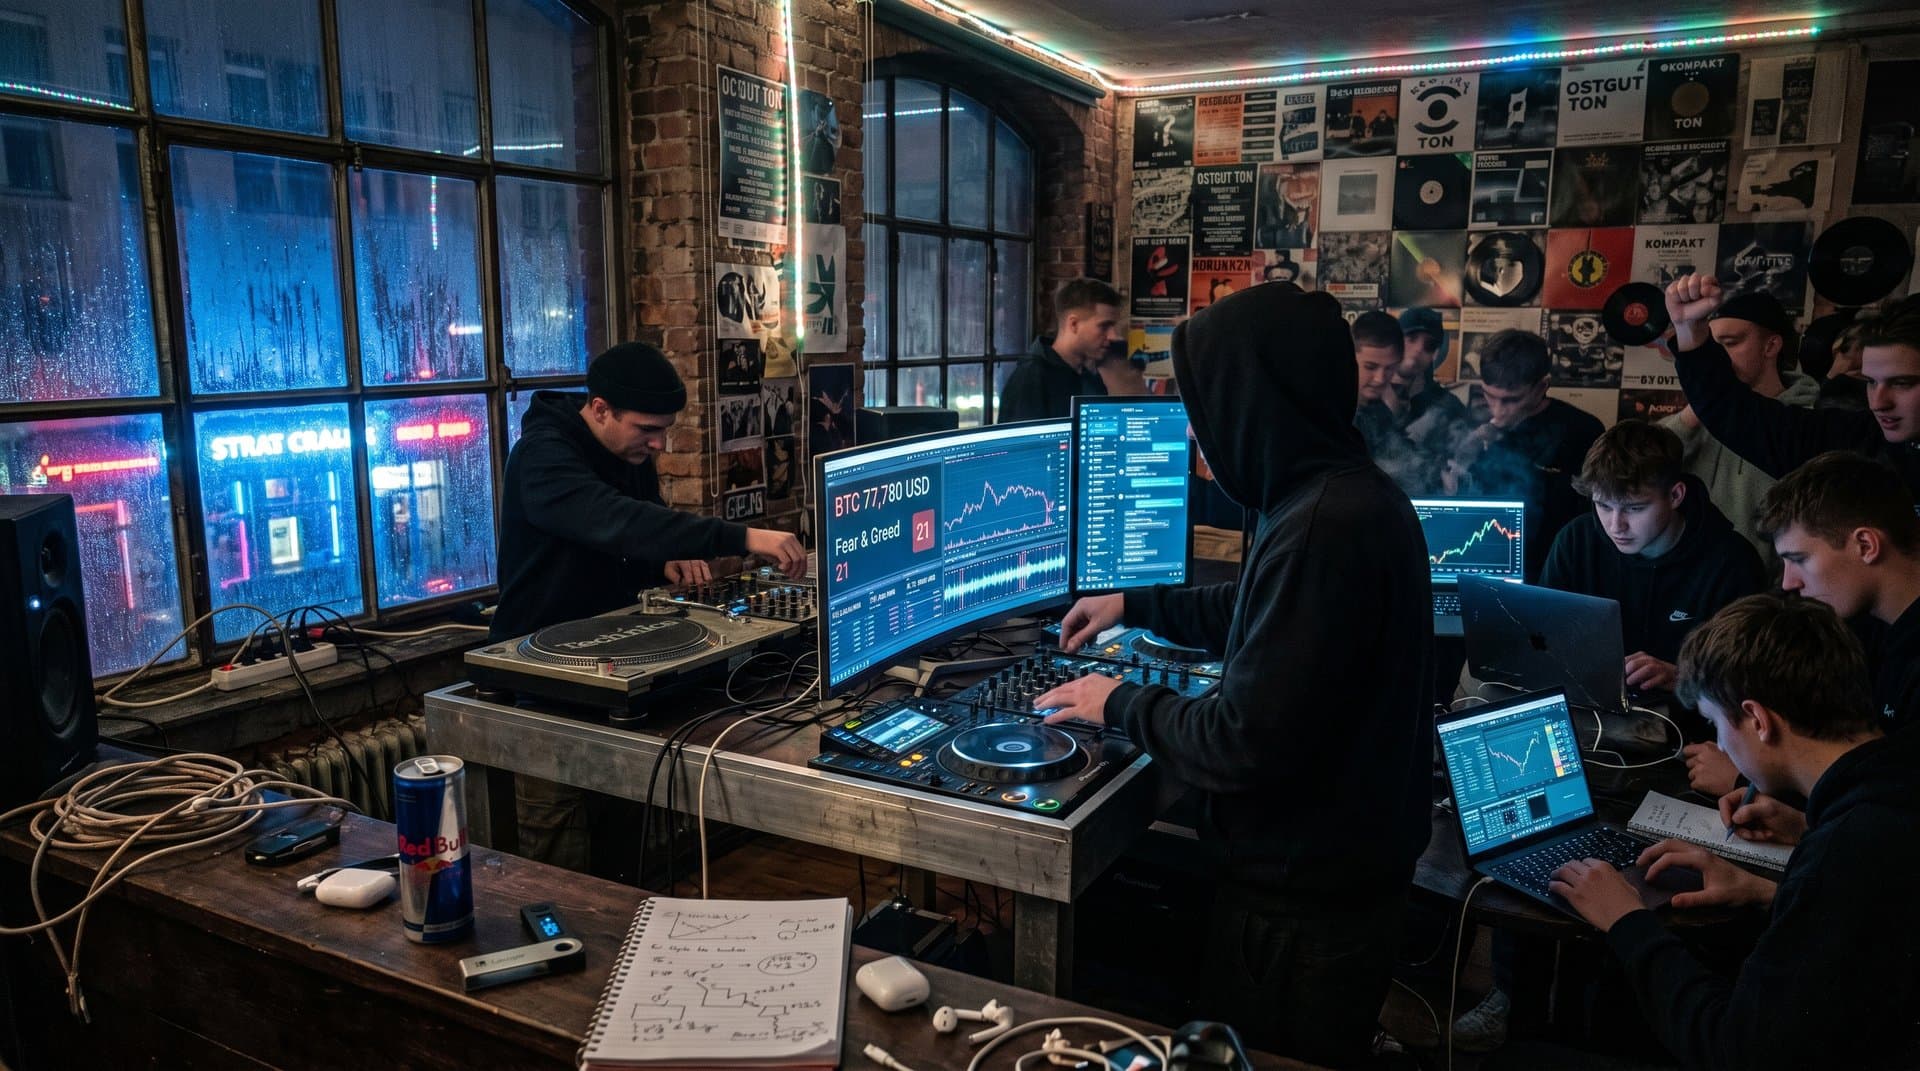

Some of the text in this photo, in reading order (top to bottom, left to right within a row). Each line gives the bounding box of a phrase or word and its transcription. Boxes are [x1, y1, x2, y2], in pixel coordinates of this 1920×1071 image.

[1566, 76, 1644, 95] OSTGUT
[762, 87, 782, 110] TON
[1568, 95, 1607, 111] TON
[1674, 117, 1703, 129] TON
[1417, 135, 1454, 149] TON
[1197, 170, 1253, 185] OSTGUT TON
[1645, 238, 1705, 249] KOMPAKT
[211, 433, 283, 461] STRAT
[835, 476, 930, 518] BTC 77,780 USD
[835, 519, 900, 557] Fear & Greed
[916, 520, 929, 541] 21
[836, 561, 848, 582] 21
[399, 834, 431, 857] Red
